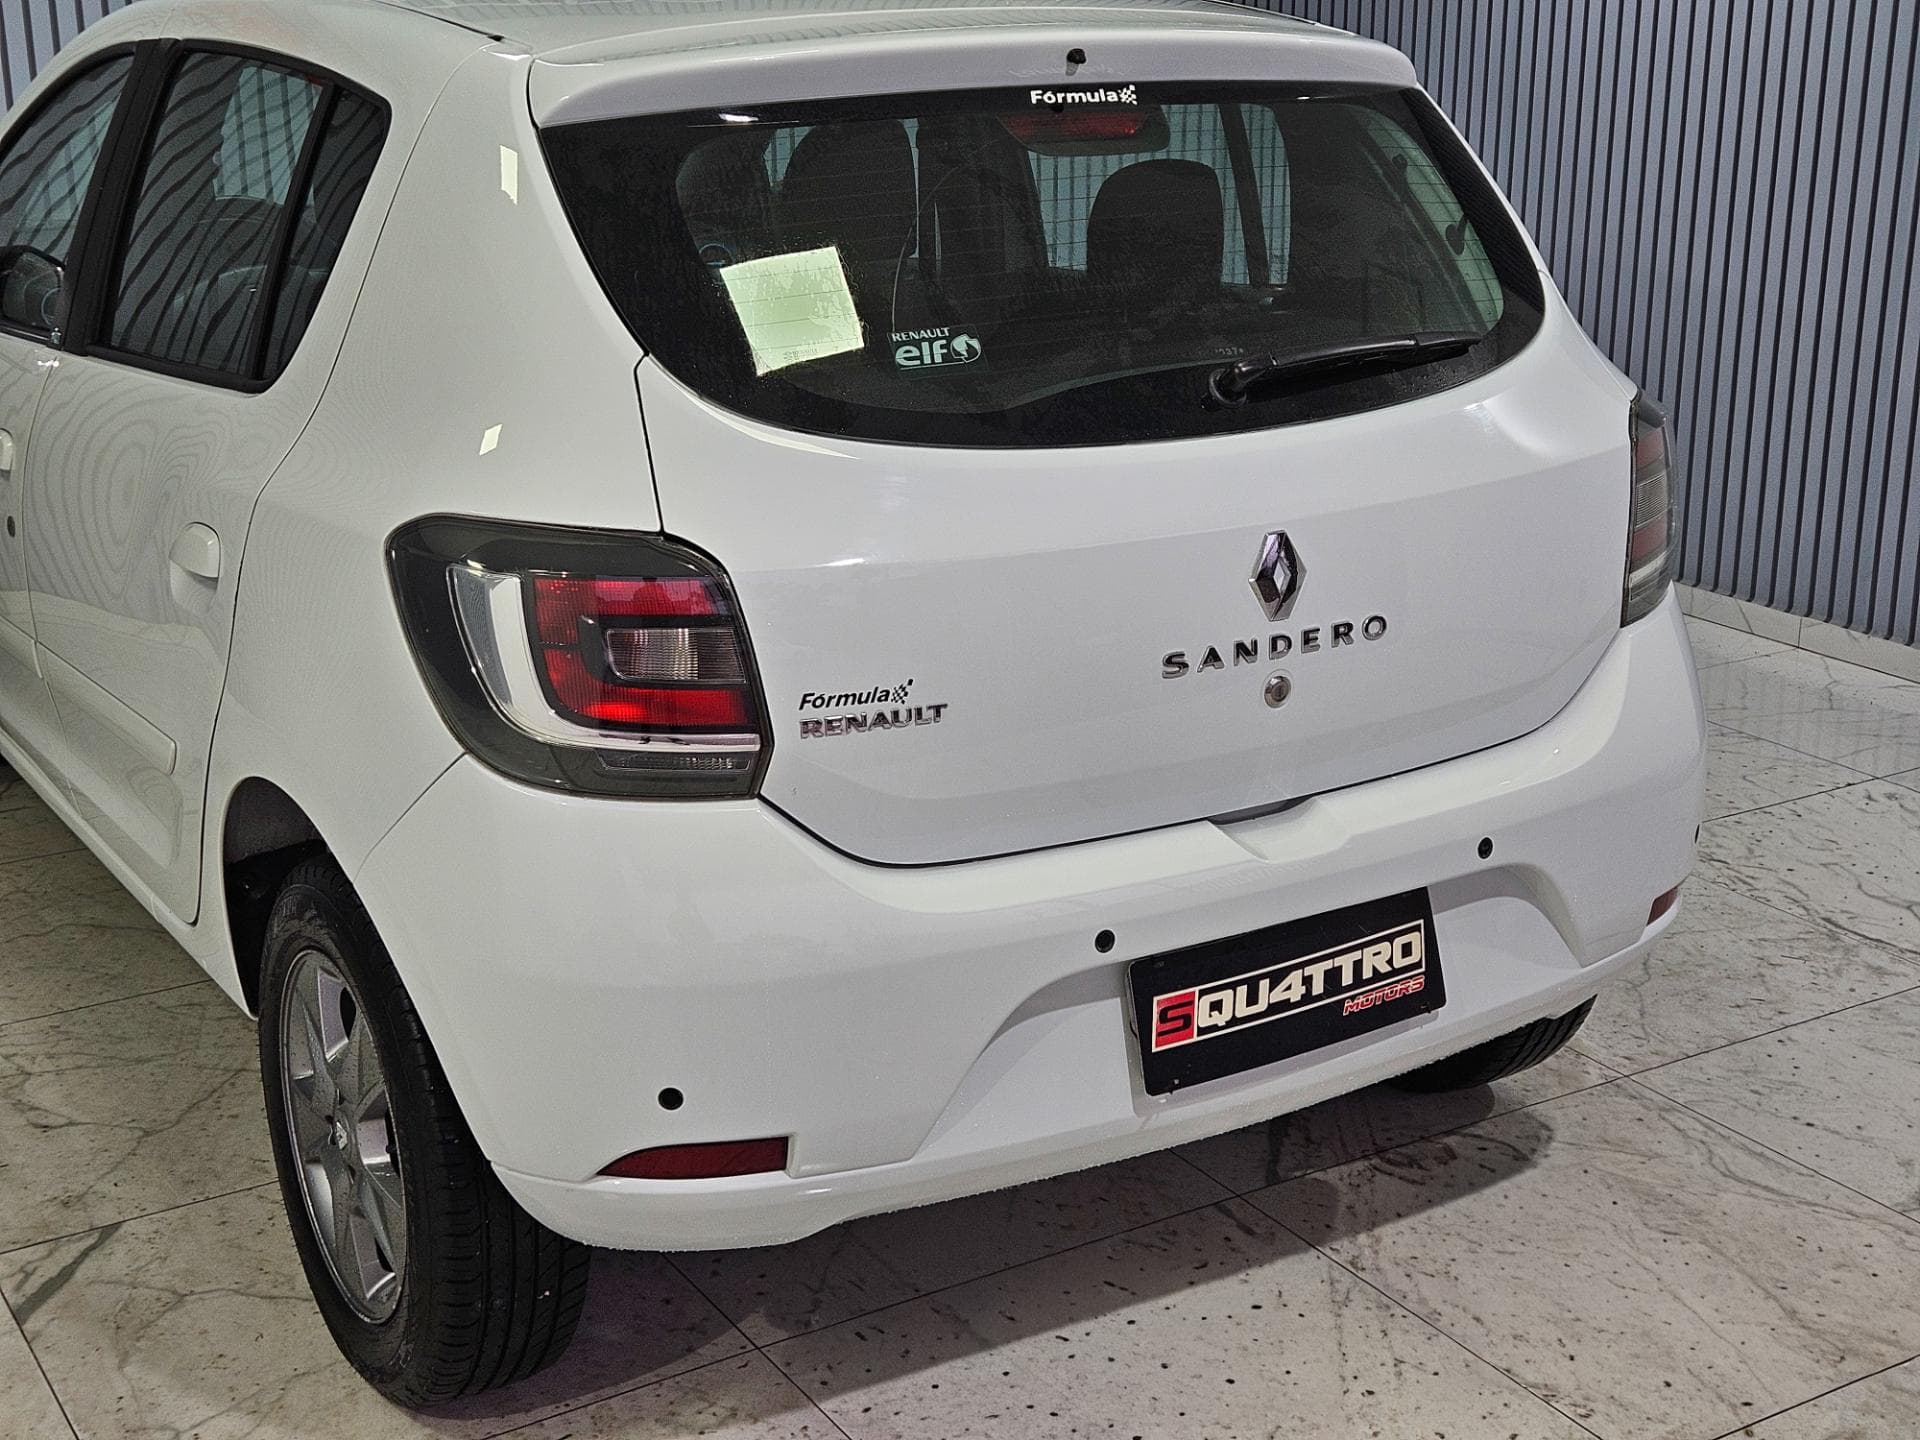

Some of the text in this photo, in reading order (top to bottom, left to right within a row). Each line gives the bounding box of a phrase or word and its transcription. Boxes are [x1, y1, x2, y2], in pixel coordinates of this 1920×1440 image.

[1030, 88, 1119, 104] Fórmula
[892, 327, 950, 341] RENAULT
[895, 339, 947, 366] elf
[1162, 615, 1387, 679] SANDERO
[799, 686, 891, 711] Fórmula
[799, 703, 948, 739] RENAULT
[1157, 931, 1422, 1038] SQU4TTRO
[1343, 975, 1424, 1016] MOTORS
